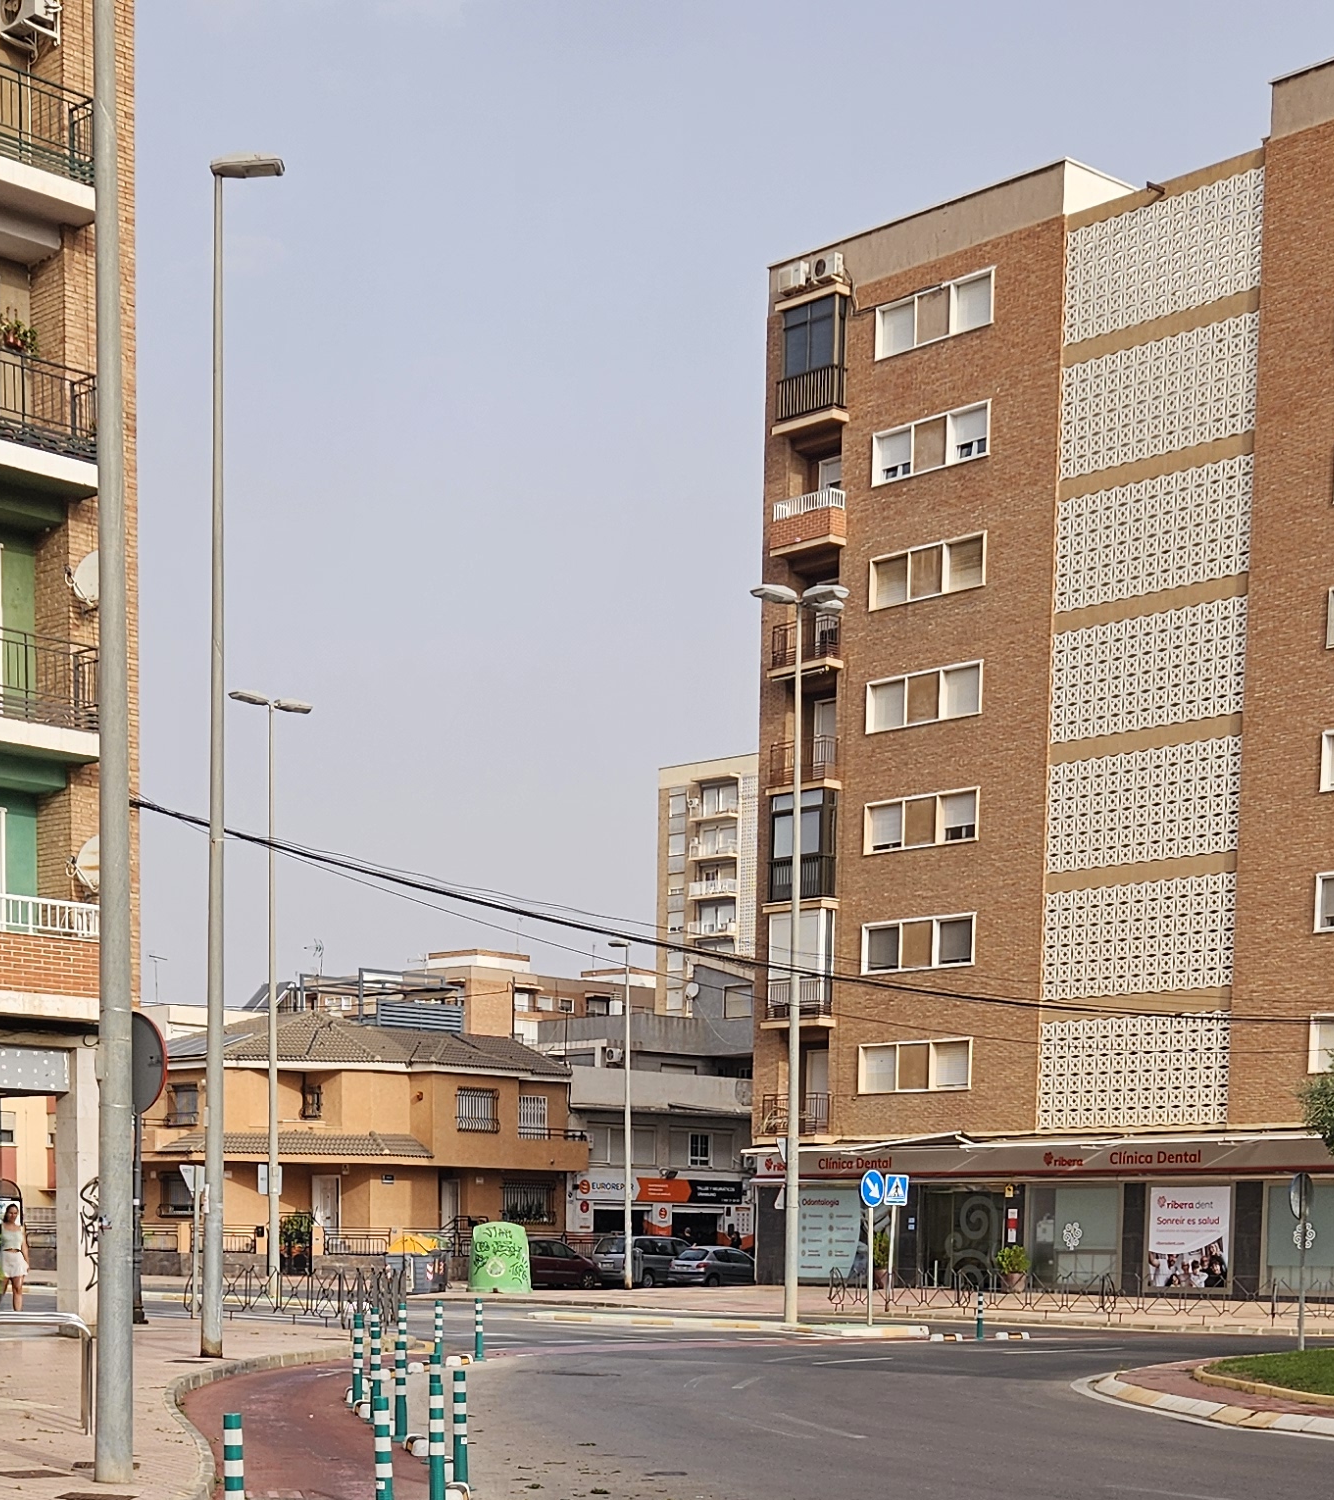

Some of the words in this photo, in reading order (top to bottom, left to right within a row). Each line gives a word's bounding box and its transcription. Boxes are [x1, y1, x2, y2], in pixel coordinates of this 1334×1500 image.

[818, 1157, 854, 1170] Clínica
[857, 1157, 892, 1170] Dental
[1054, 1154, 1084, 1167] ribera
[1110, 1151, 1153, 1165] Clínica
[1157, 1150, 1201, 1164] Dental
[1167, 1200, 1194, 1209] ribera
[1195, 1201, 1213, 1209] dent
[1157, 1215, 1185, 1225] Sonreír
[1198, 1216, 1220, 1225] salud
